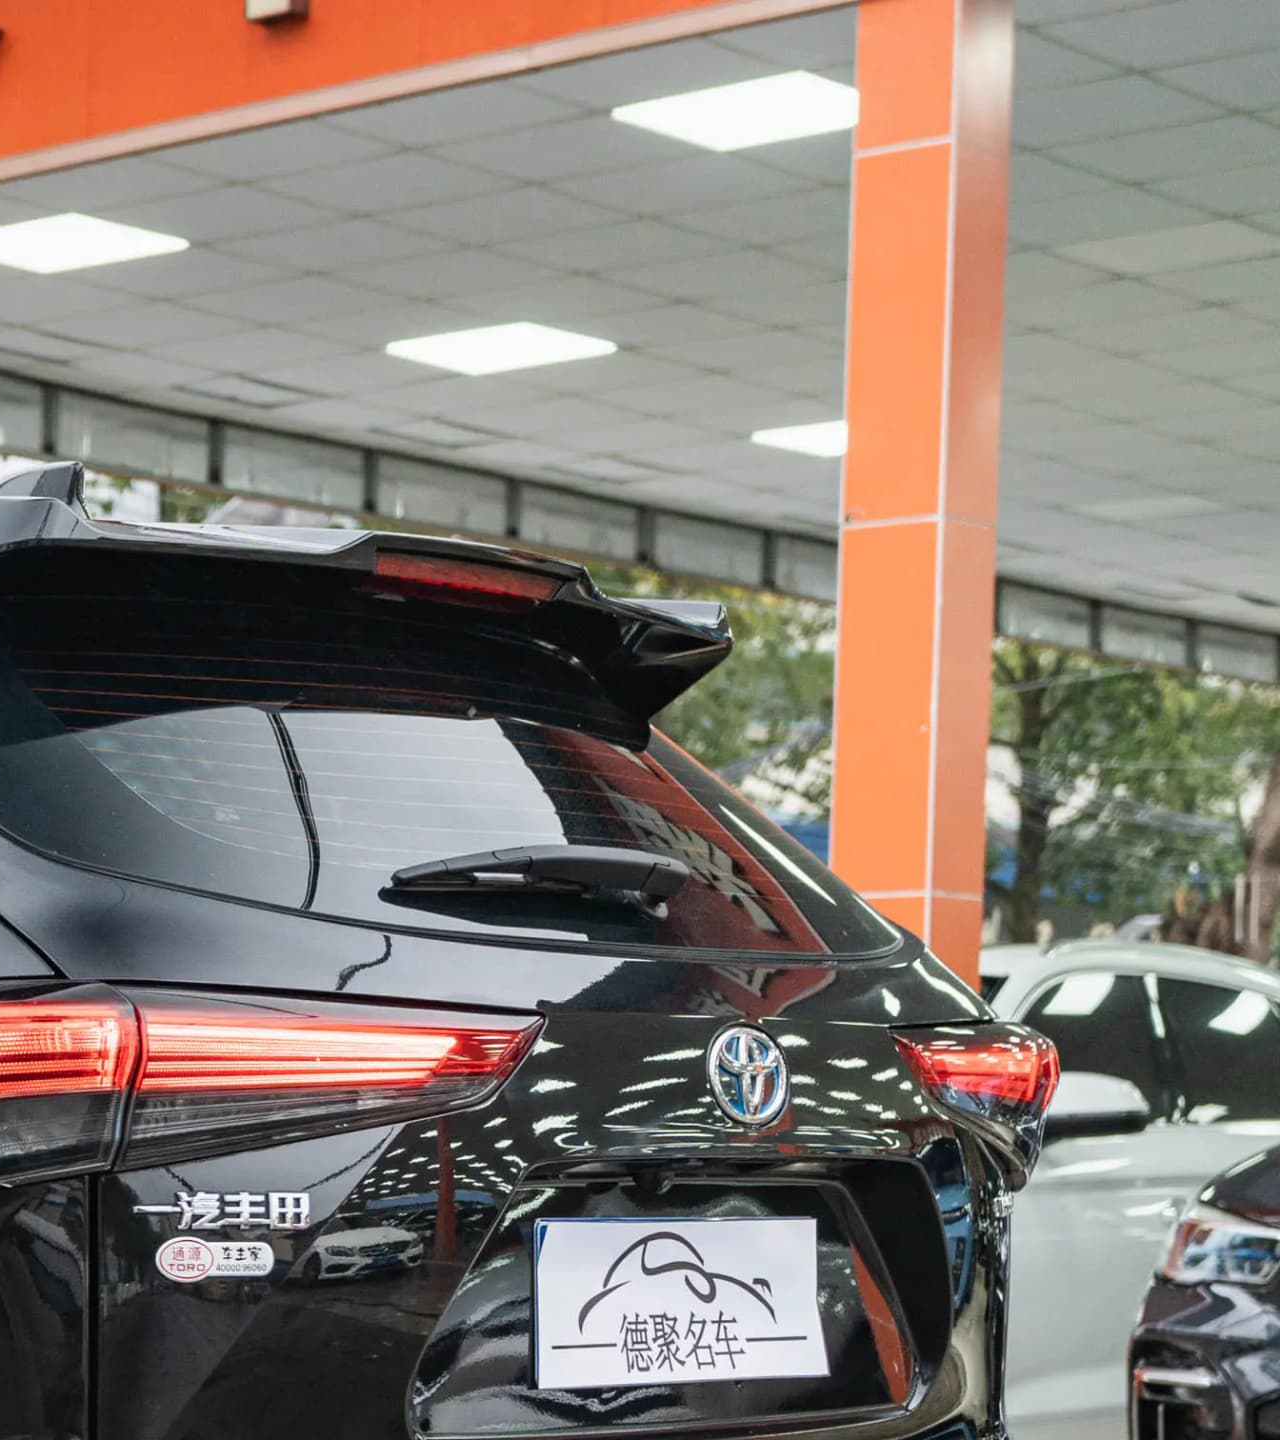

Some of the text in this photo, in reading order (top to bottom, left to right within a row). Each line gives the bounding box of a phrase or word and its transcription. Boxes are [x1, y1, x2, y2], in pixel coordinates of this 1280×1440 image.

[133, 1191, 309, 1229] 一汽丰田
[167, 1263, 206, 1272] TORO
[620, 1311, 746, 1373] 德聚名车
